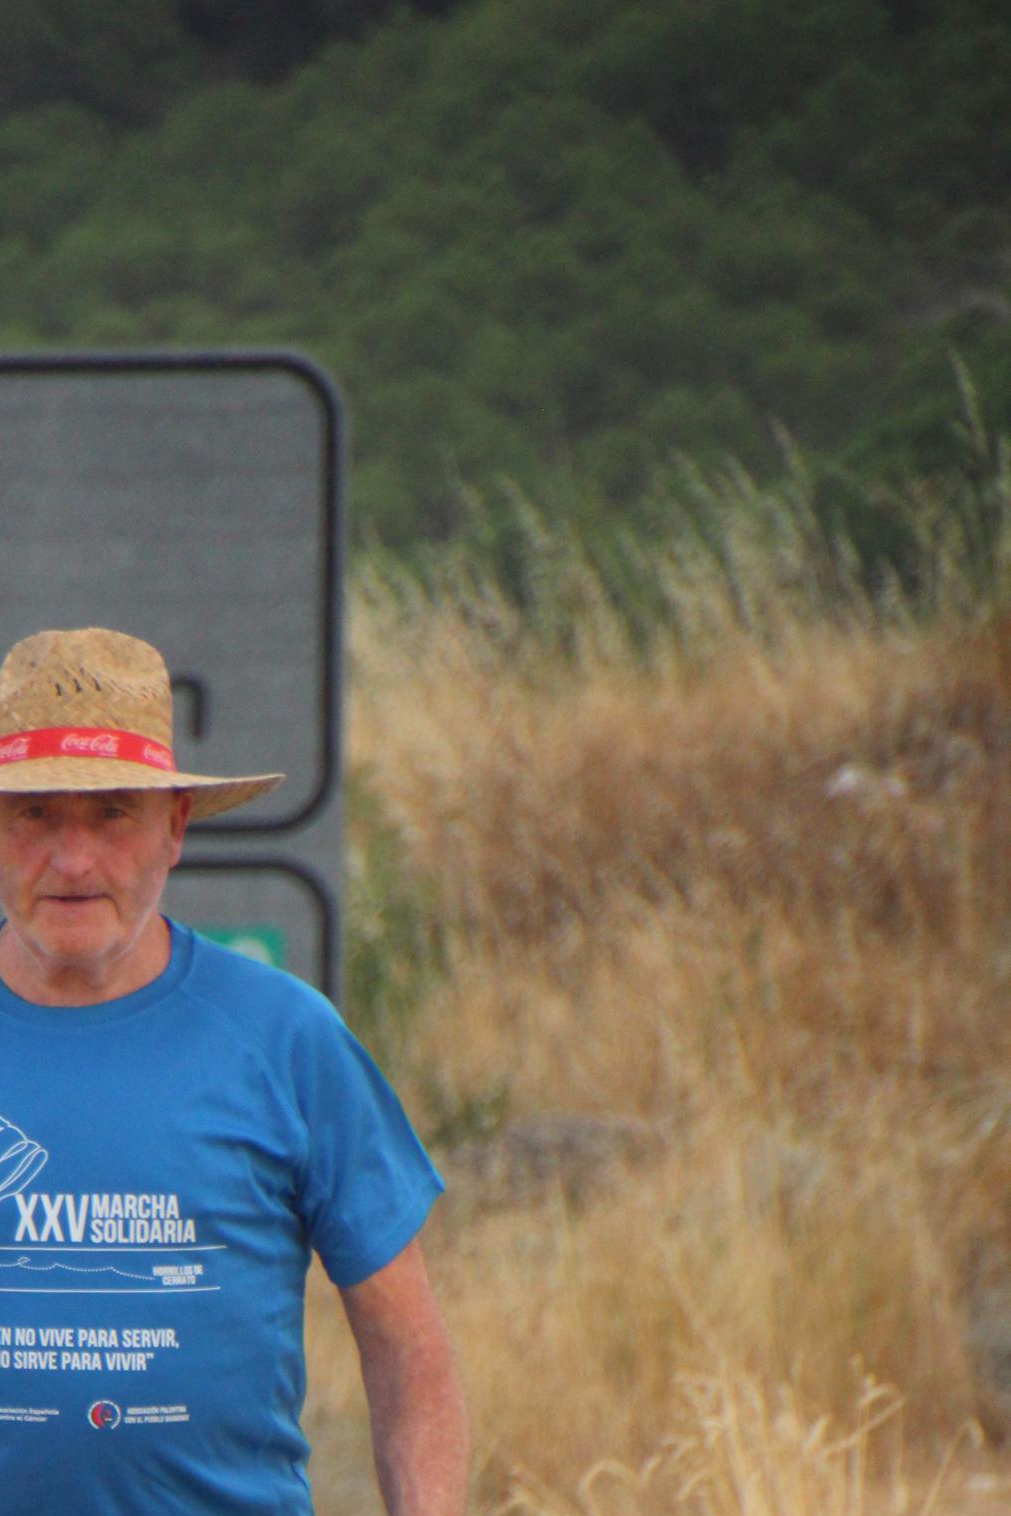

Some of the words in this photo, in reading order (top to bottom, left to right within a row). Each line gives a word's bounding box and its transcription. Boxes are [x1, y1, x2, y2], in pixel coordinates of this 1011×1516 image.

[14, 1194, 90, 1242] XXV
[92, 1194, 180, 1219] MARCHA
[91, 1219, 196, 1243] SOLIDARIA
[15, 1327, 35, 1346] NO
[39, 1328, 74, 1347] VIVE
[78, 1328, 118, 1348] PARA
[122, 1329, 179, 1349] SERVIR,
[14, 1351, 57, 1370] SIRVE
[61, 1352, 102, 1371] PARA
